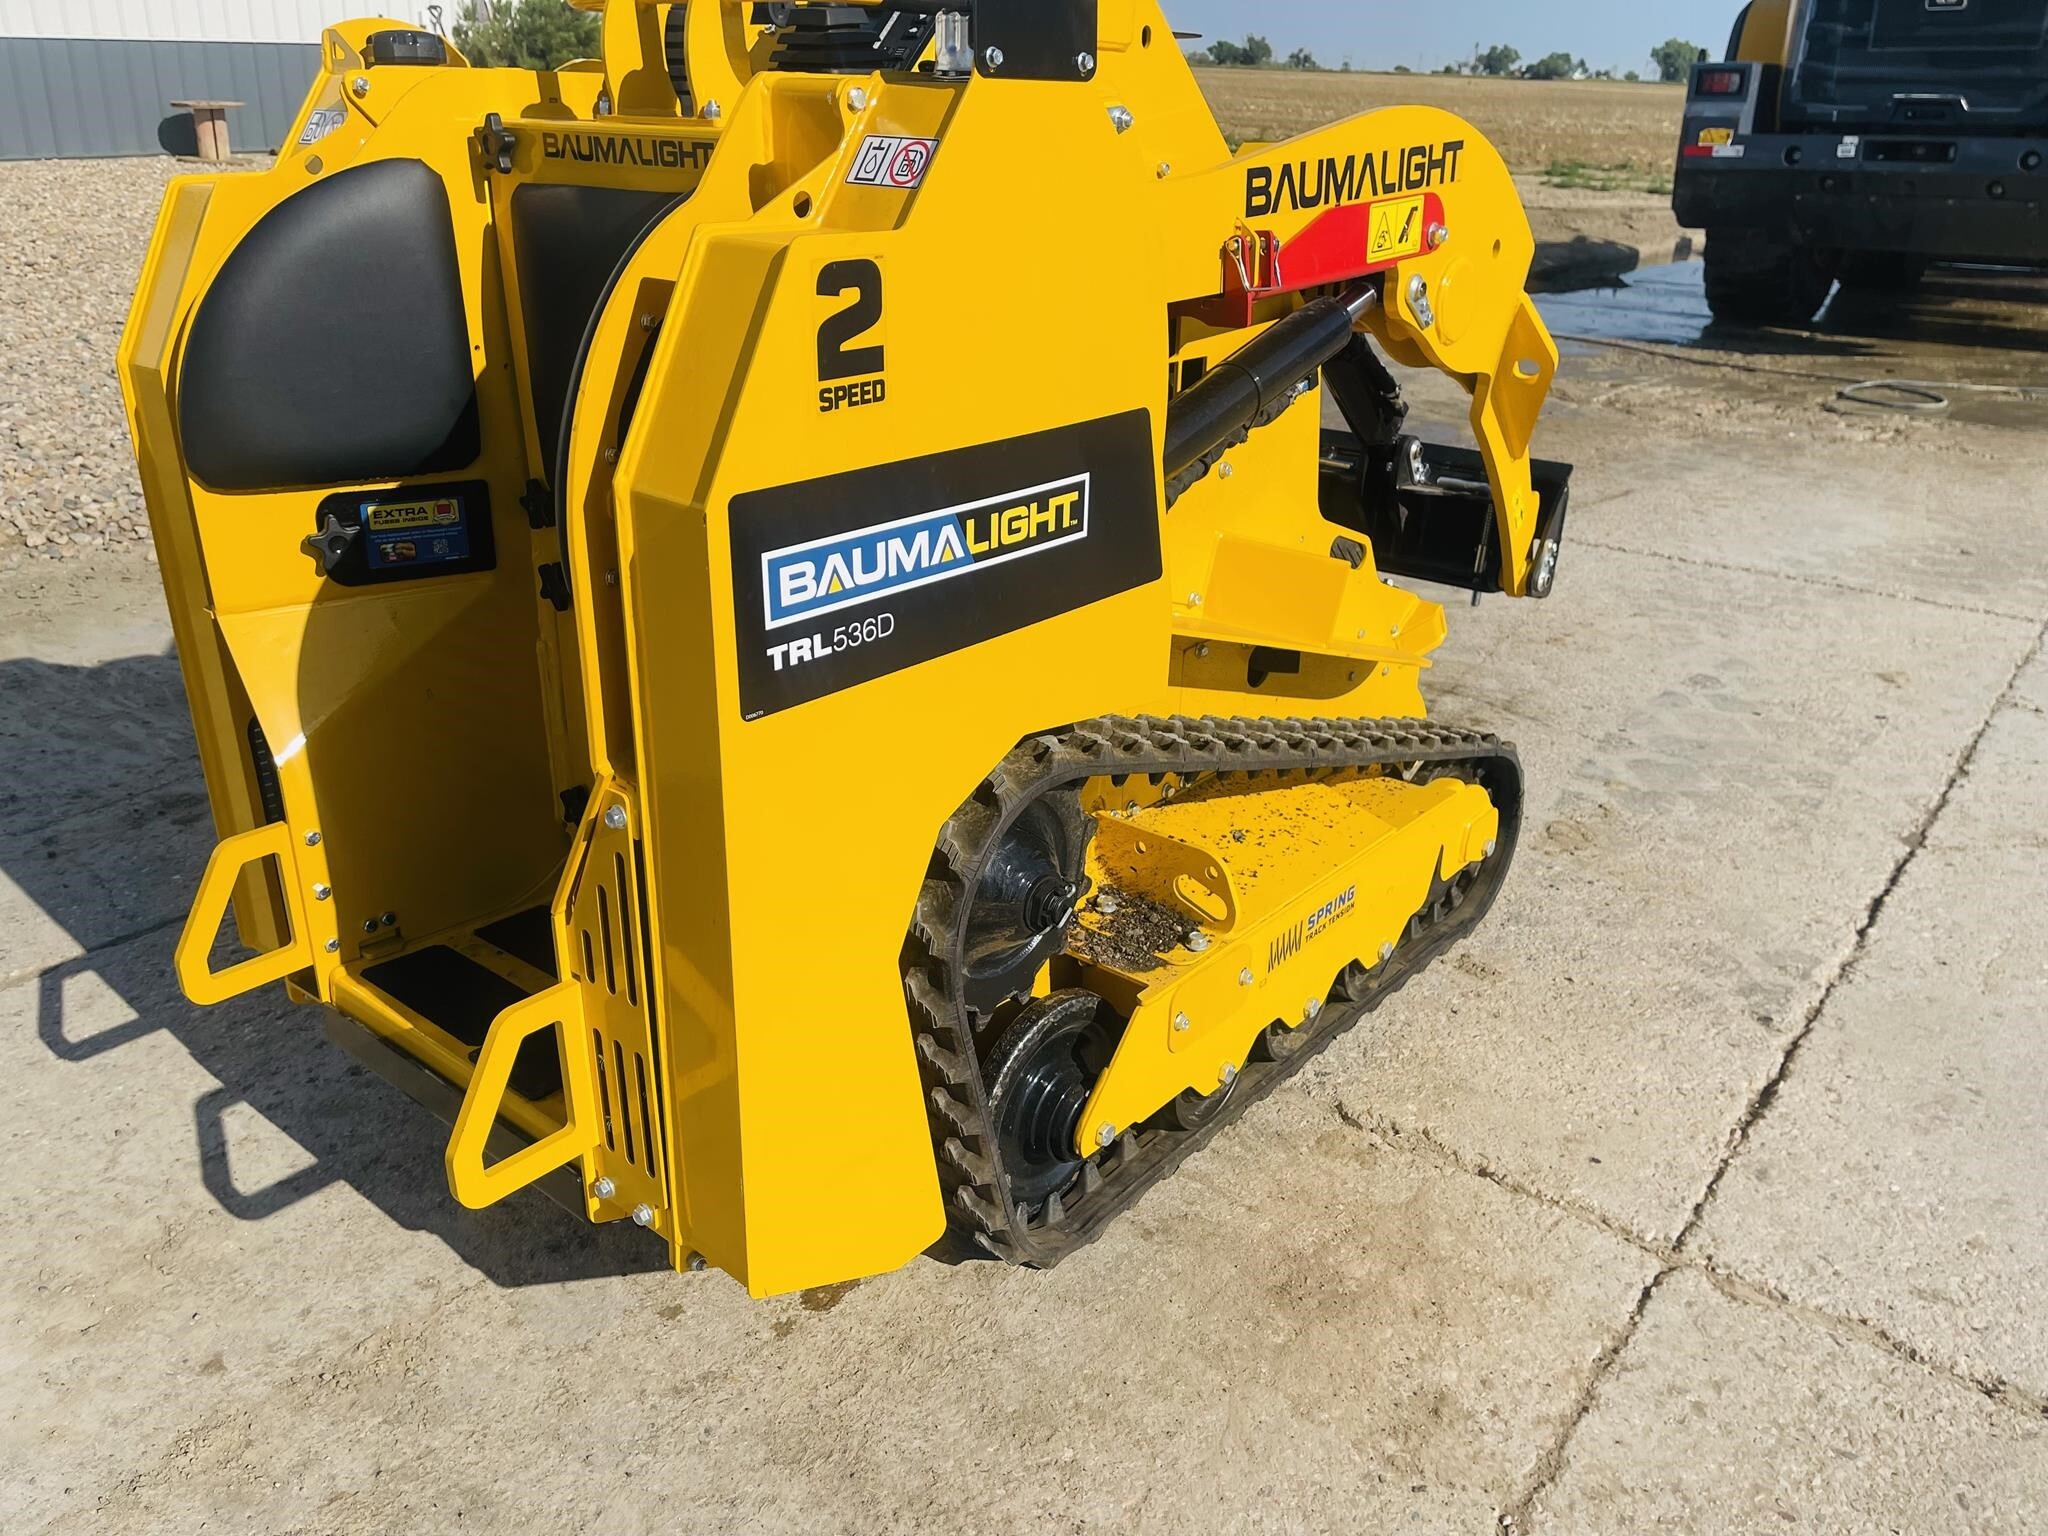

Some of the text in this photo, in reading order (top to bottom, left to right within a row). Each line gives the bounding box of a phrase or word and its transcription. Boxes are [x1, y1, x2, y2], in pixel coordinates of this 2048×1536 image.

[542, 132, 715, 169] BAUMALIGHT
[1245, 140, 1464, 218] BAUMALIGHT
[816, 258, 884, 382] 2
[819, 378, 885, 413] SPEED
[373, 506, 428, 519] EXTRA
[402, 515, 429, 523] INSIDE
[779, 490, 1079, 608] BAUMALIGHT
[766, 612, 895, 671] TRL536D
[1305, 902, 1355, 943] TRACK TENSION
[1307, 884, 1355, 931] SPRING
